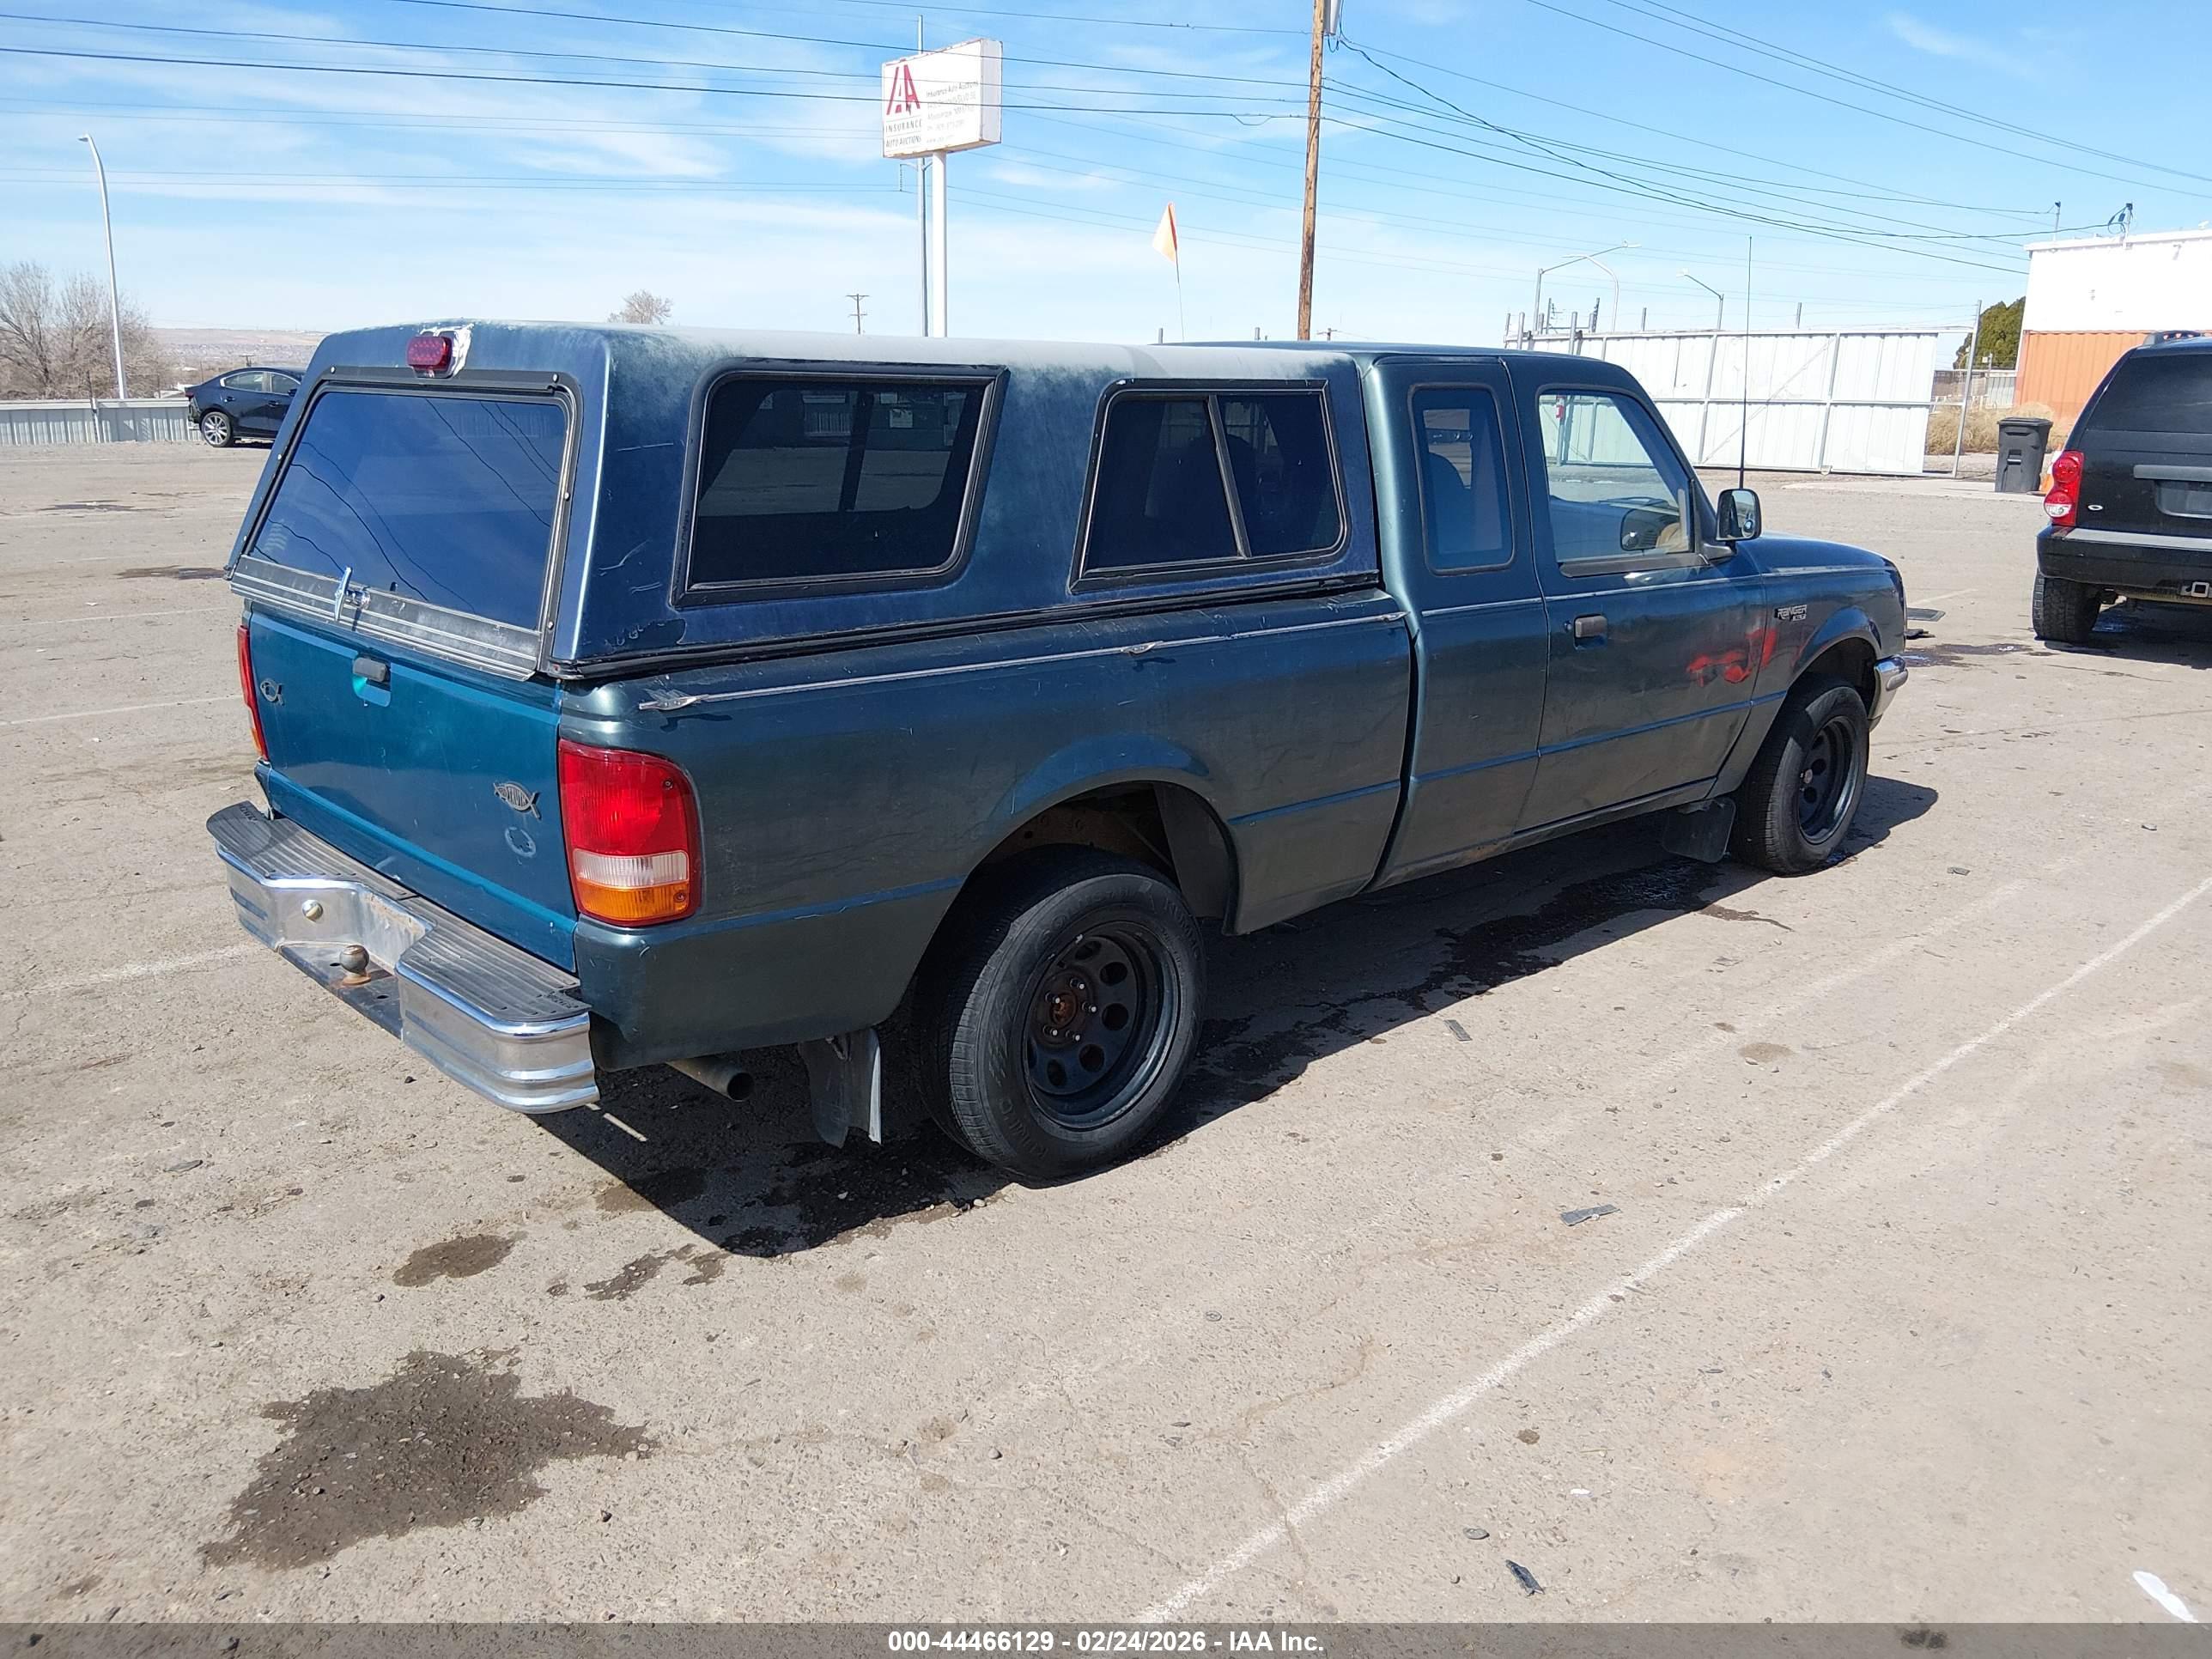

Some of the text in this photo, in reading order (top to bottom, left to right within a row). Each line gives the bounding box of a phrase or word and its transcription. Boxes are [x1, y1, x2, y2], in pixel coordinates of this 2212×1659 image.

[885, 118, 921, 133] INSURANCE
[885, 137, 899, 148] AUTO
[899, 135, 921, 145] AUCTIONS
[1778, 605, 1808, 620] RANGER
